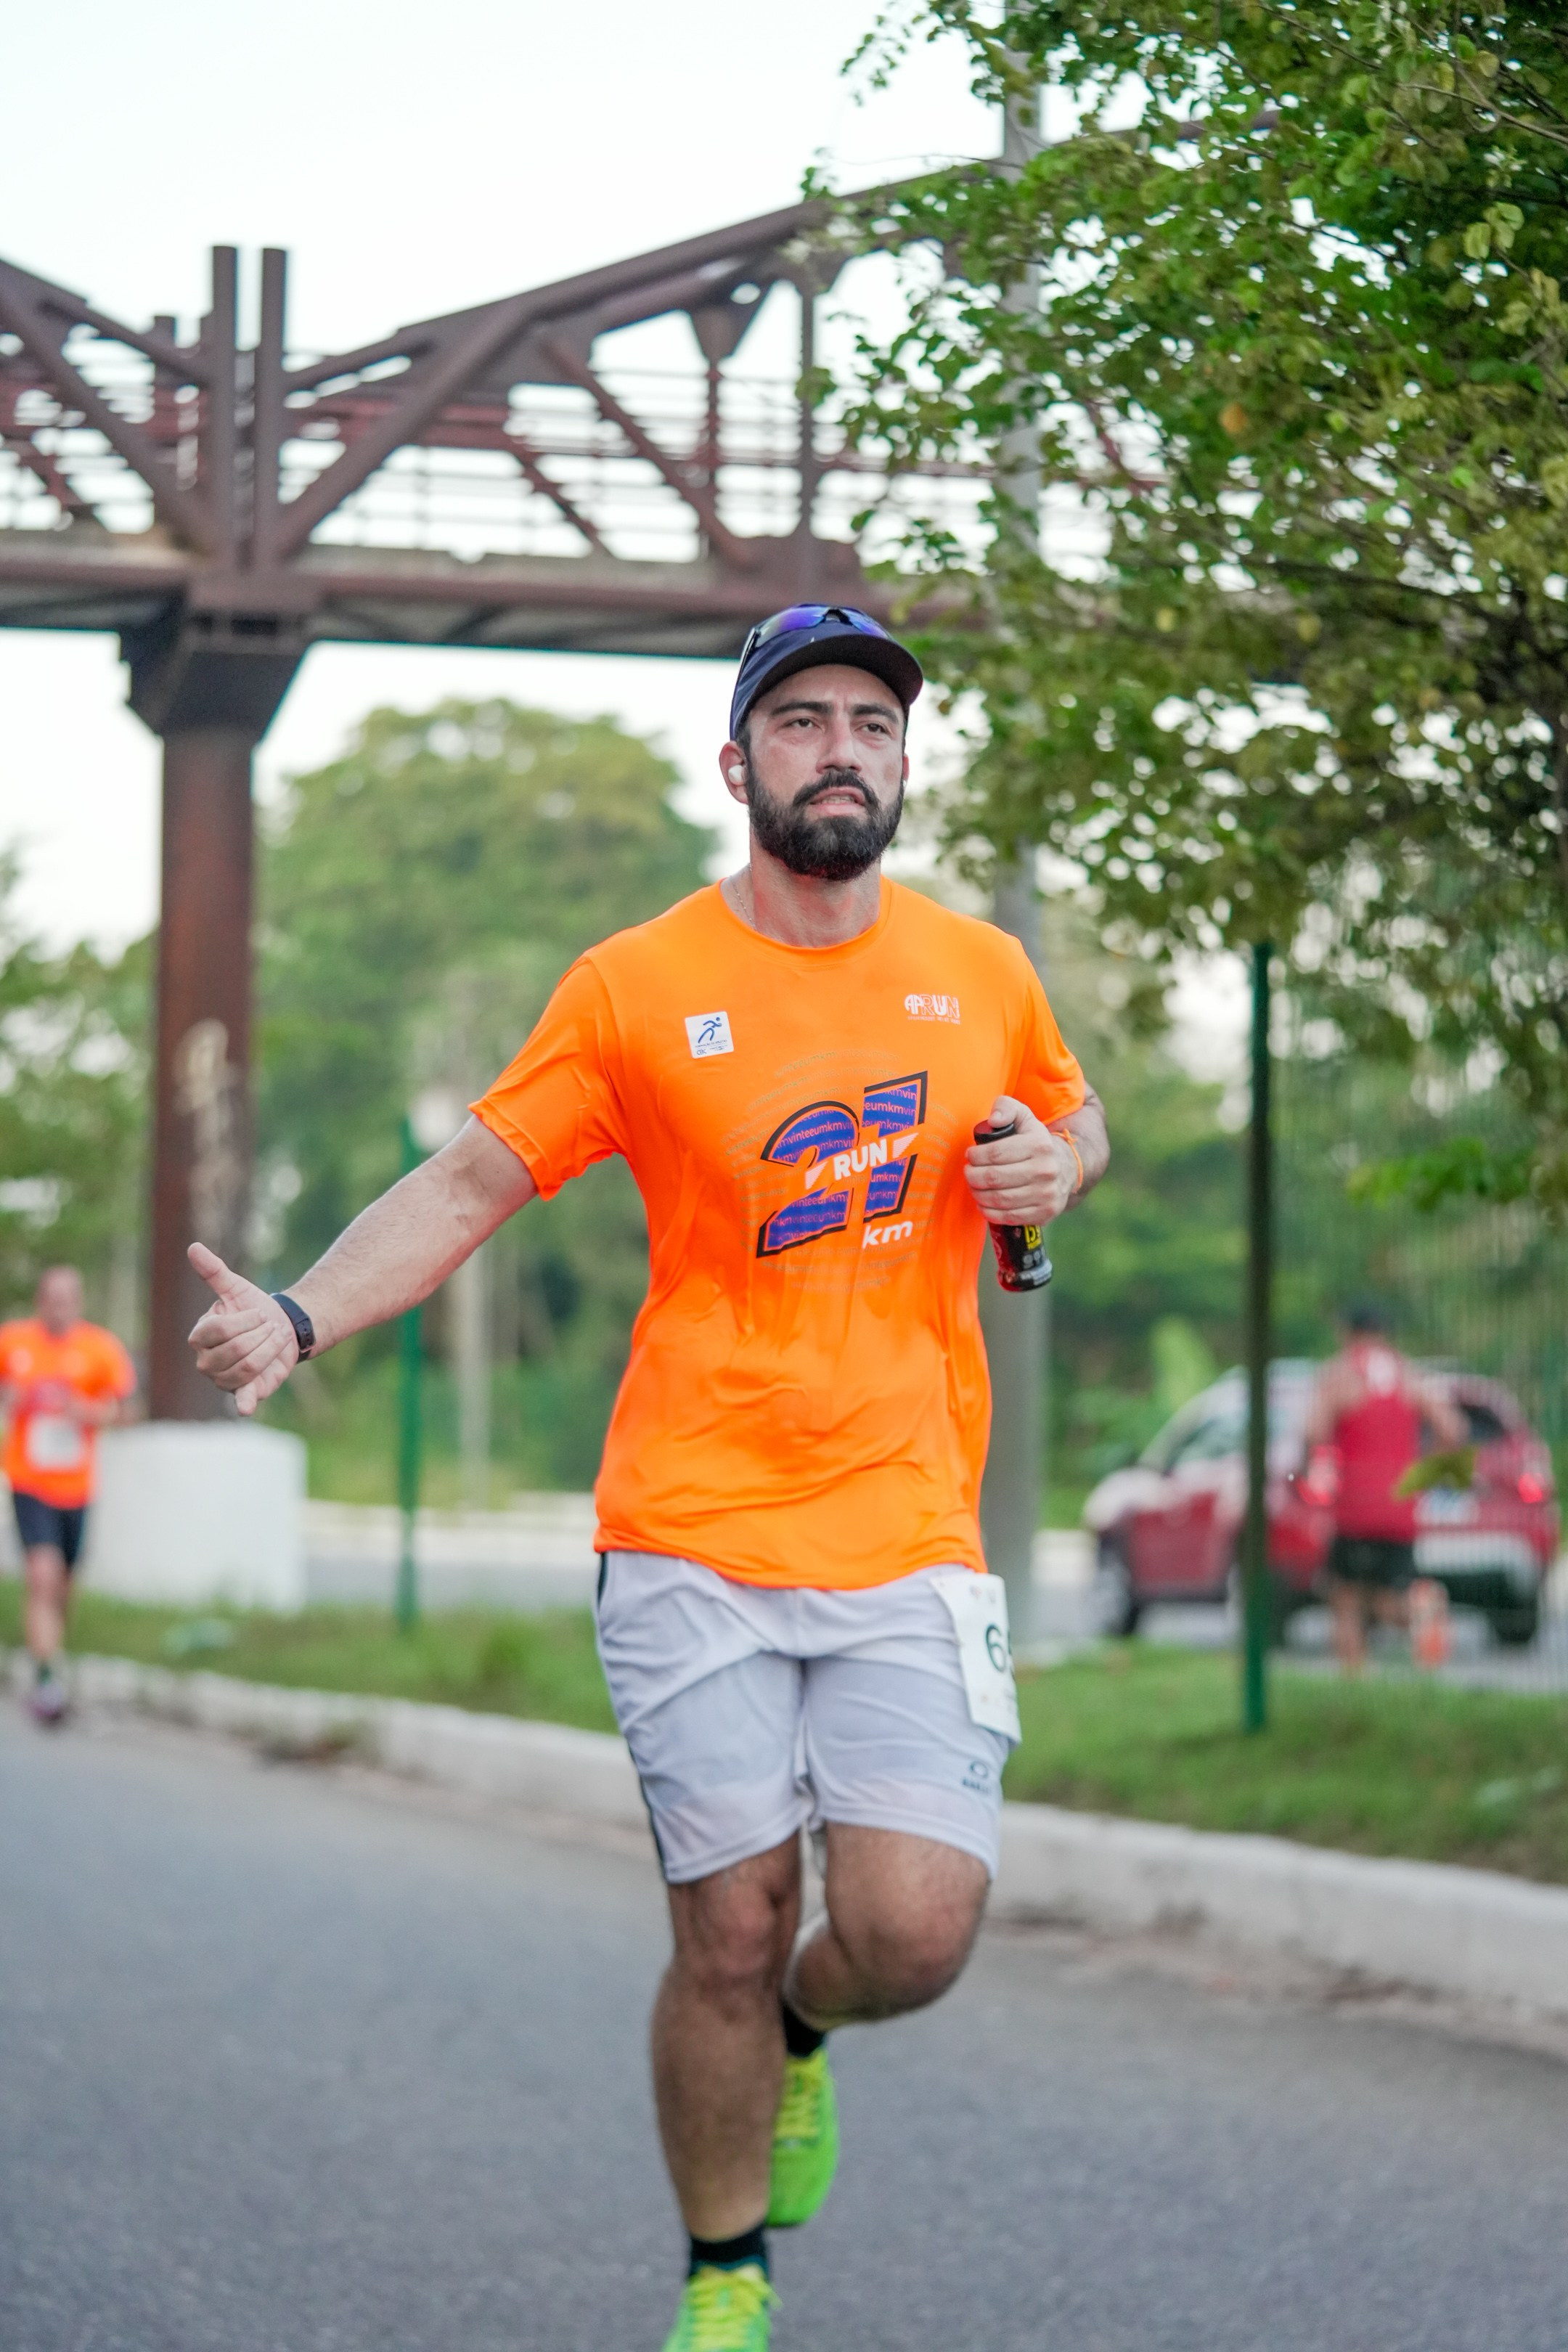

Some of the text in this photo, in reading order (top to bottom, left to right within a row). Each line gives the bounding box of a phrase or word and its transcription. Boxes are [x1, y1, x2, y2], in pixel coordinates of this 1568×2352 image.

[756, 1070, 928, 1259] 21
[833, 1138, 888, 1181] RUN
[862, 1221, 913, 1250] km
